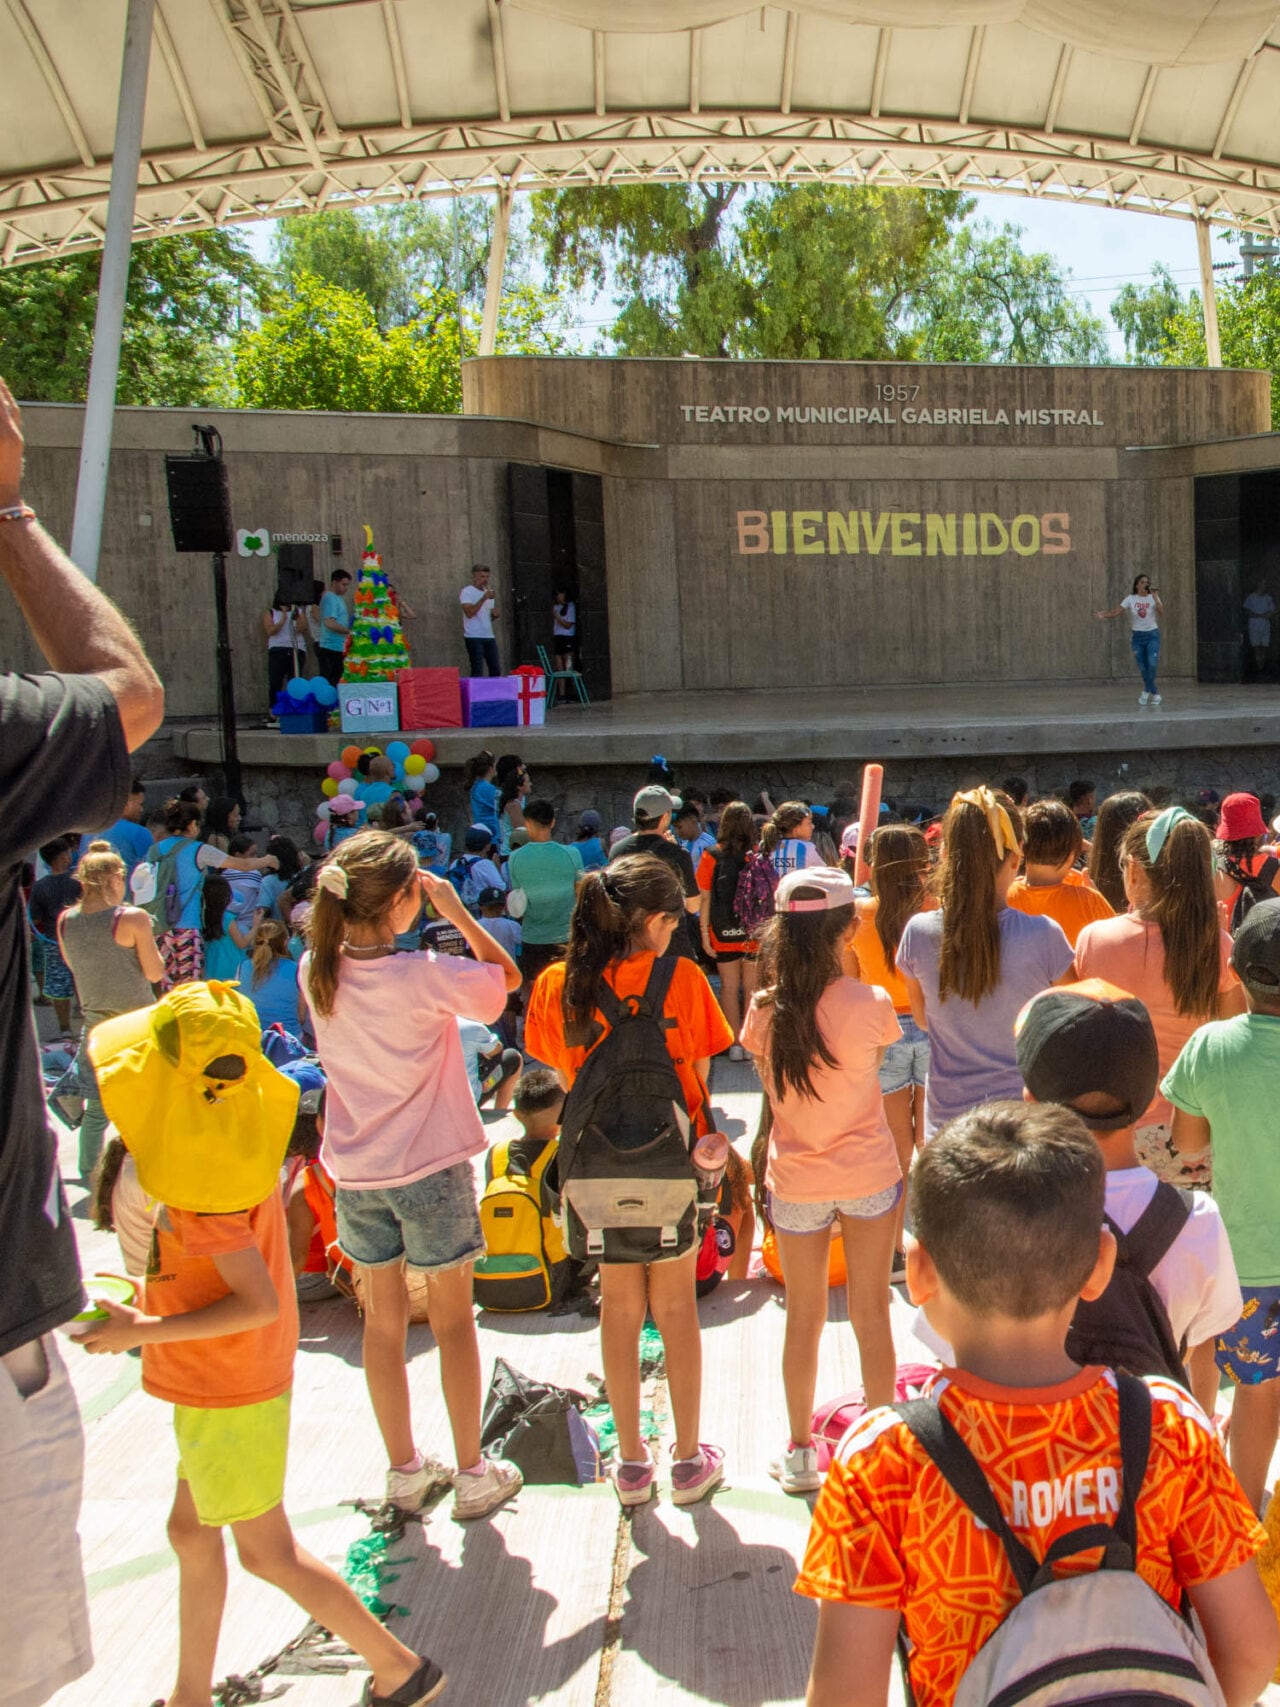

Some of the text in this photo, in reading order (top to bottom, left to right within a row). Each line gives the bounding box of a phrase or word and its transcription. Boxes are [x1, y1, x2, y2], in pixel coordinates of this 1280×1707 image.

[875, 384, 920, 401] 1957
[680, 405, 1104, 426] TEATRO MUNICIPAL GABRIELA MISTRAL
[272, 531, 329, 542] mendoza
[737, 510, 1072, 556] BIENVENIDOS
[346, 699, 362, 716] G
[771, 857, 795, 868] ESSI
